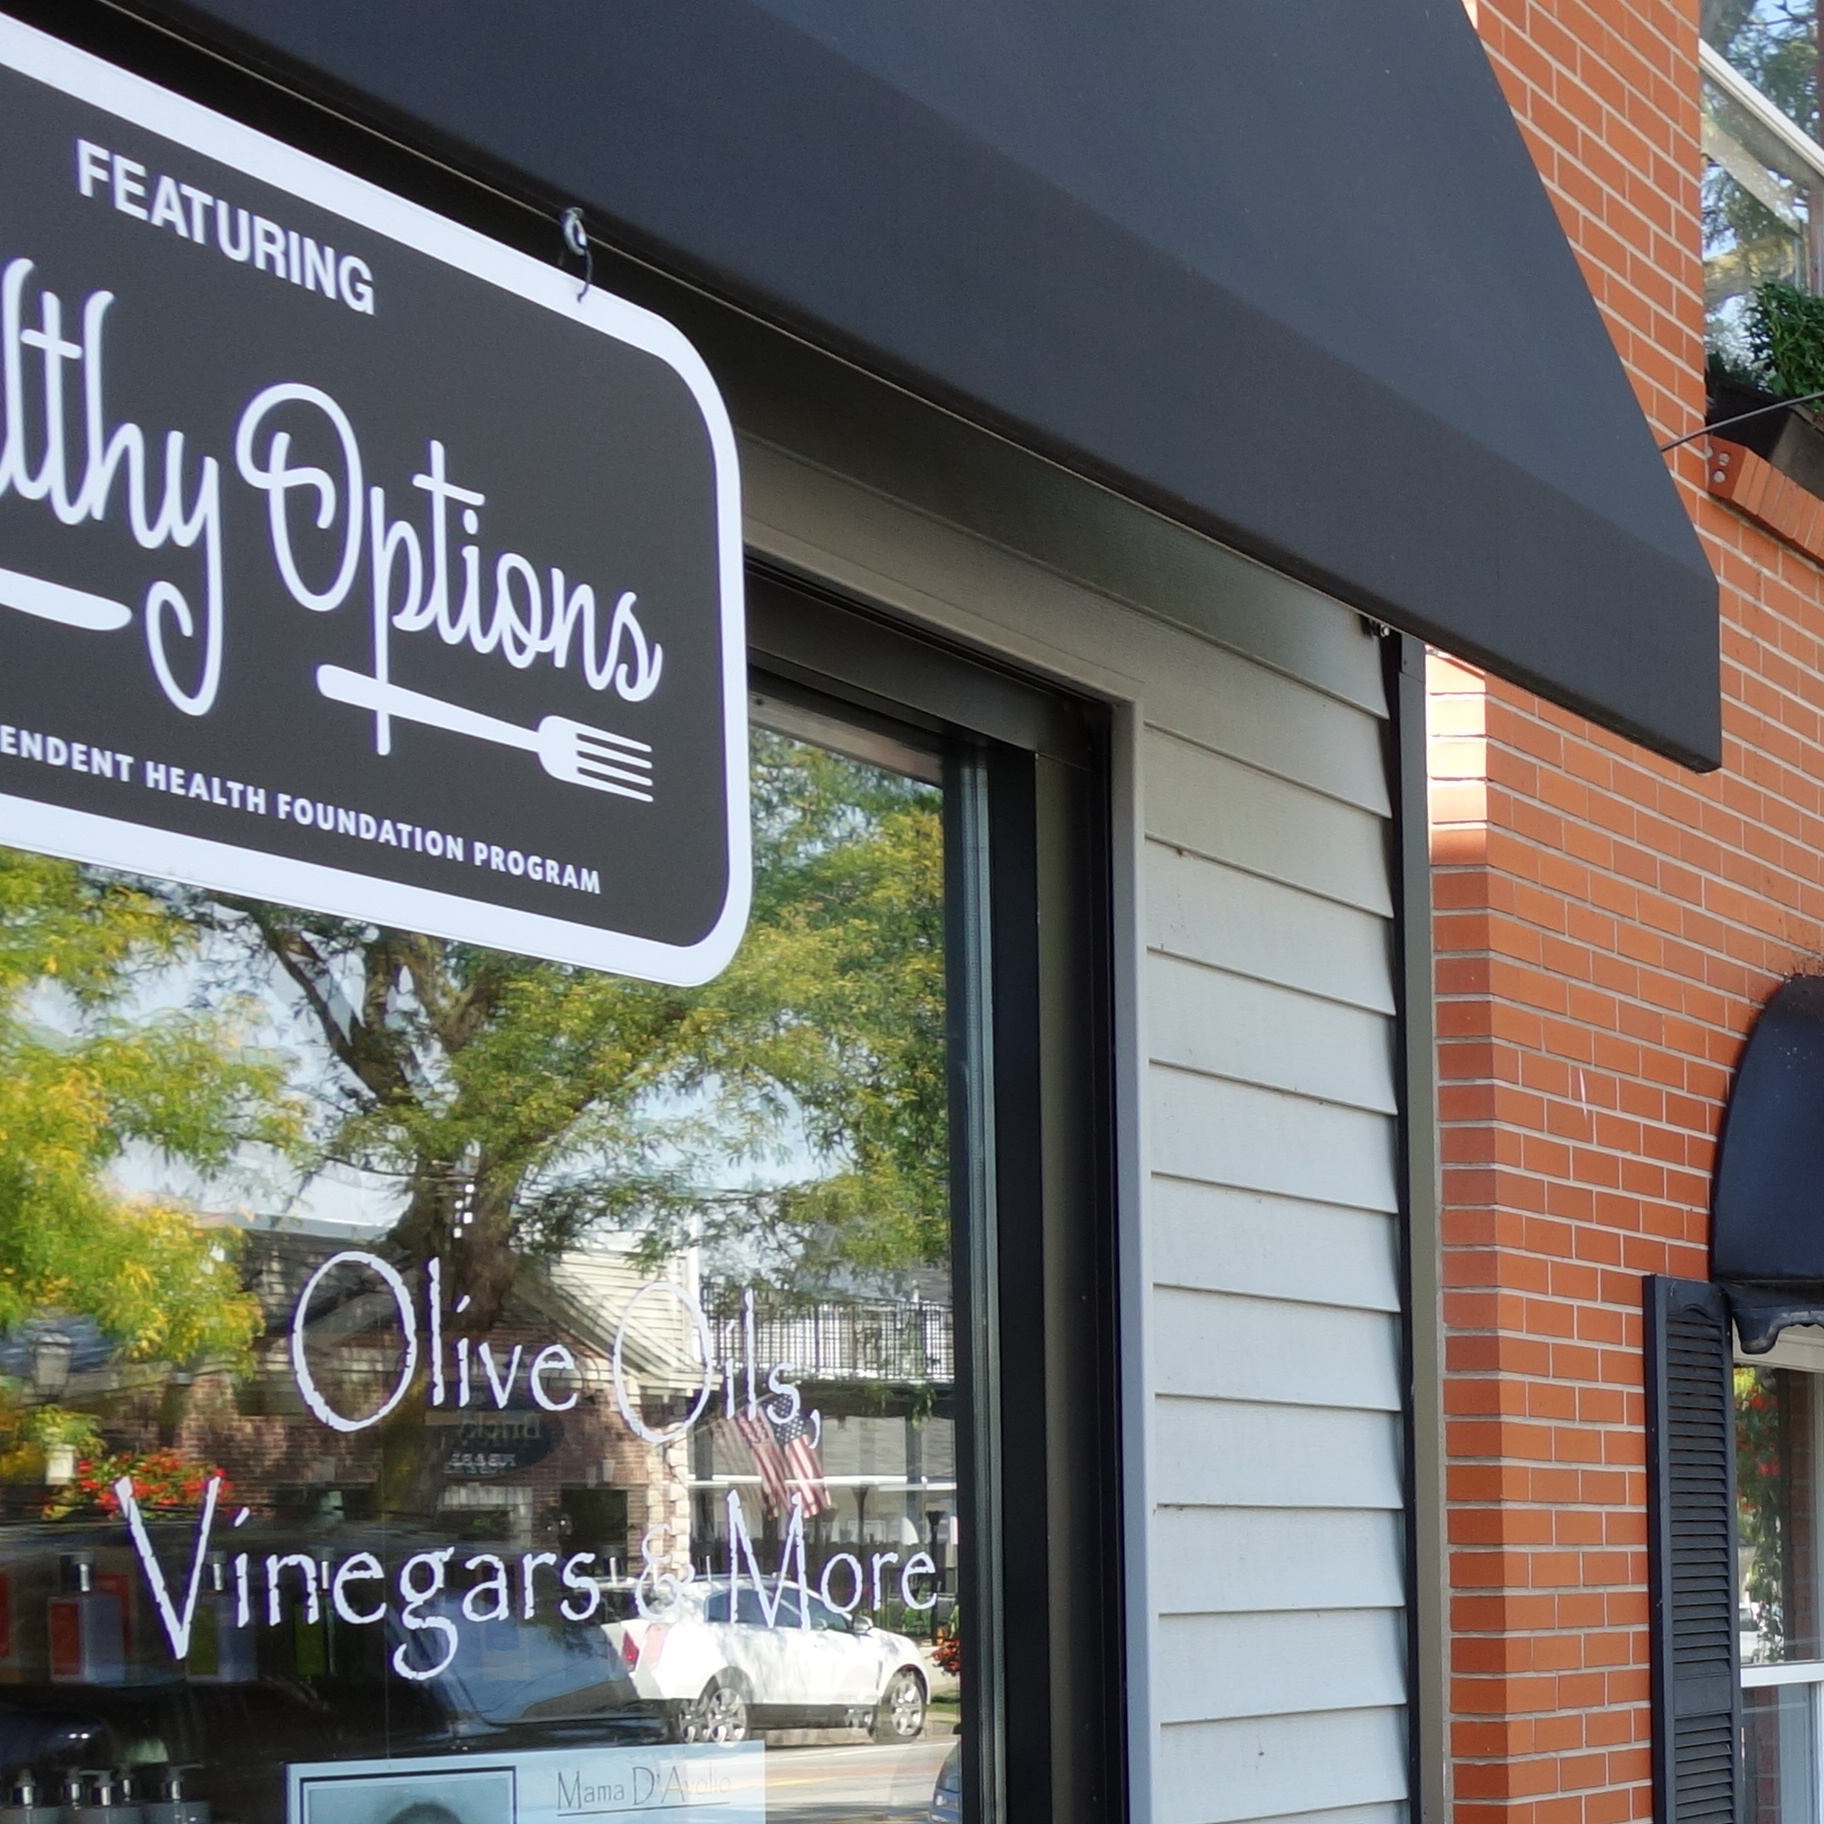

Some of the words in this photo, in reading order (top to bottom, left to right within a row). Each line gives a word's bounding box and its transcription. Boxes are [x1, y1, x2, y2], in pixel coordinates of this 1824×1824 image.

[77, 139, 376, 316] FEATURING
[236, 382, 664, 757] Options
[0, 724, 133, 783] ENDENT
[145, 760, 267, 816] HEALTH
[277, 793, 465, 862] FOUNDATION
[473, 840, 602, 895] PROGRAM
[291, 1249, 582, 1434] Olive
[613, 1280, 822, 1451] Oils,
[115, 1475, 598, 1681] Vinegars
[635, 1520, 697, 1623] &
[728, 1489, 938, 1632] More
[557, 1770, 625, 1810] Mama
